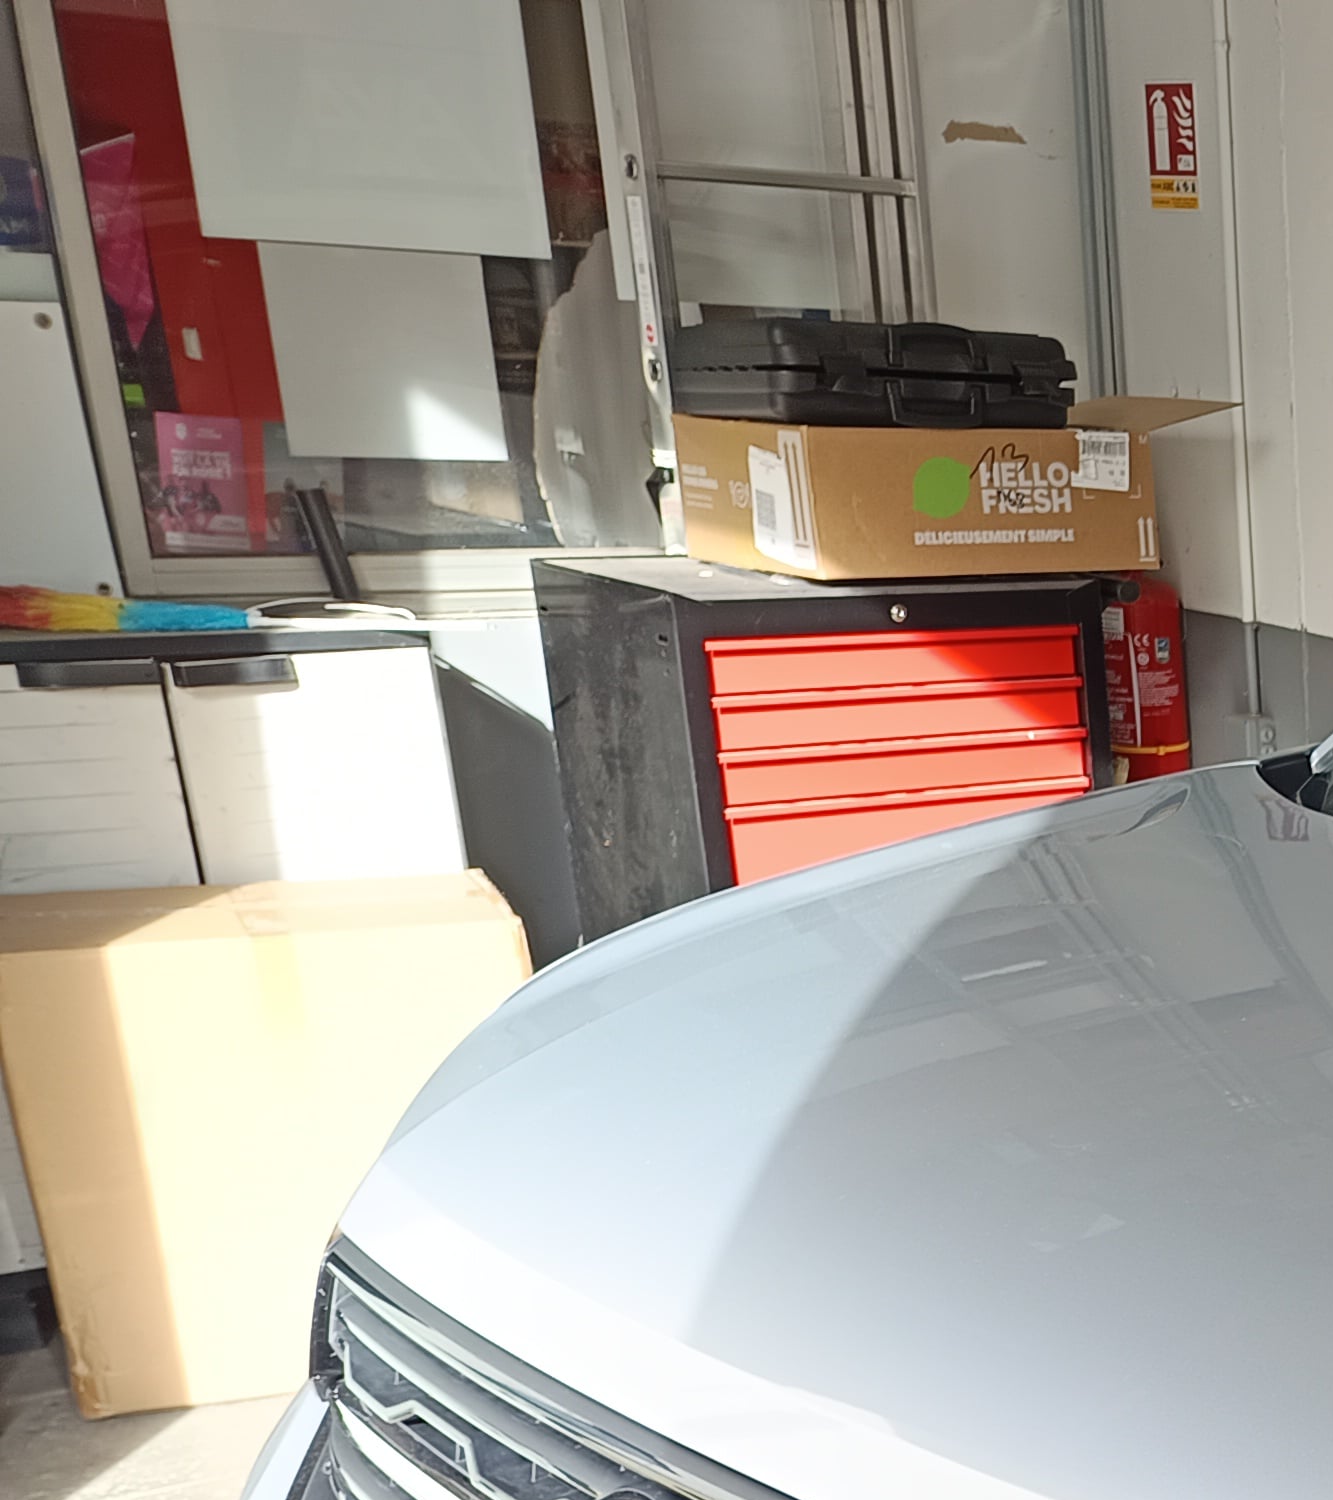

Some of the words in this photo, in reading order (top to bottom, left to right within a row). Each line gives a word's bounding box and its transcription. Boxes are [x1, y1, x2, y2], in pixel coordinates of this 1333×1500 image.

[979, 460, 1070, 488] HELLO
[981, 487, 1073, 515] FRESH
[1027, 528, 1075, 544] SIMPLE
